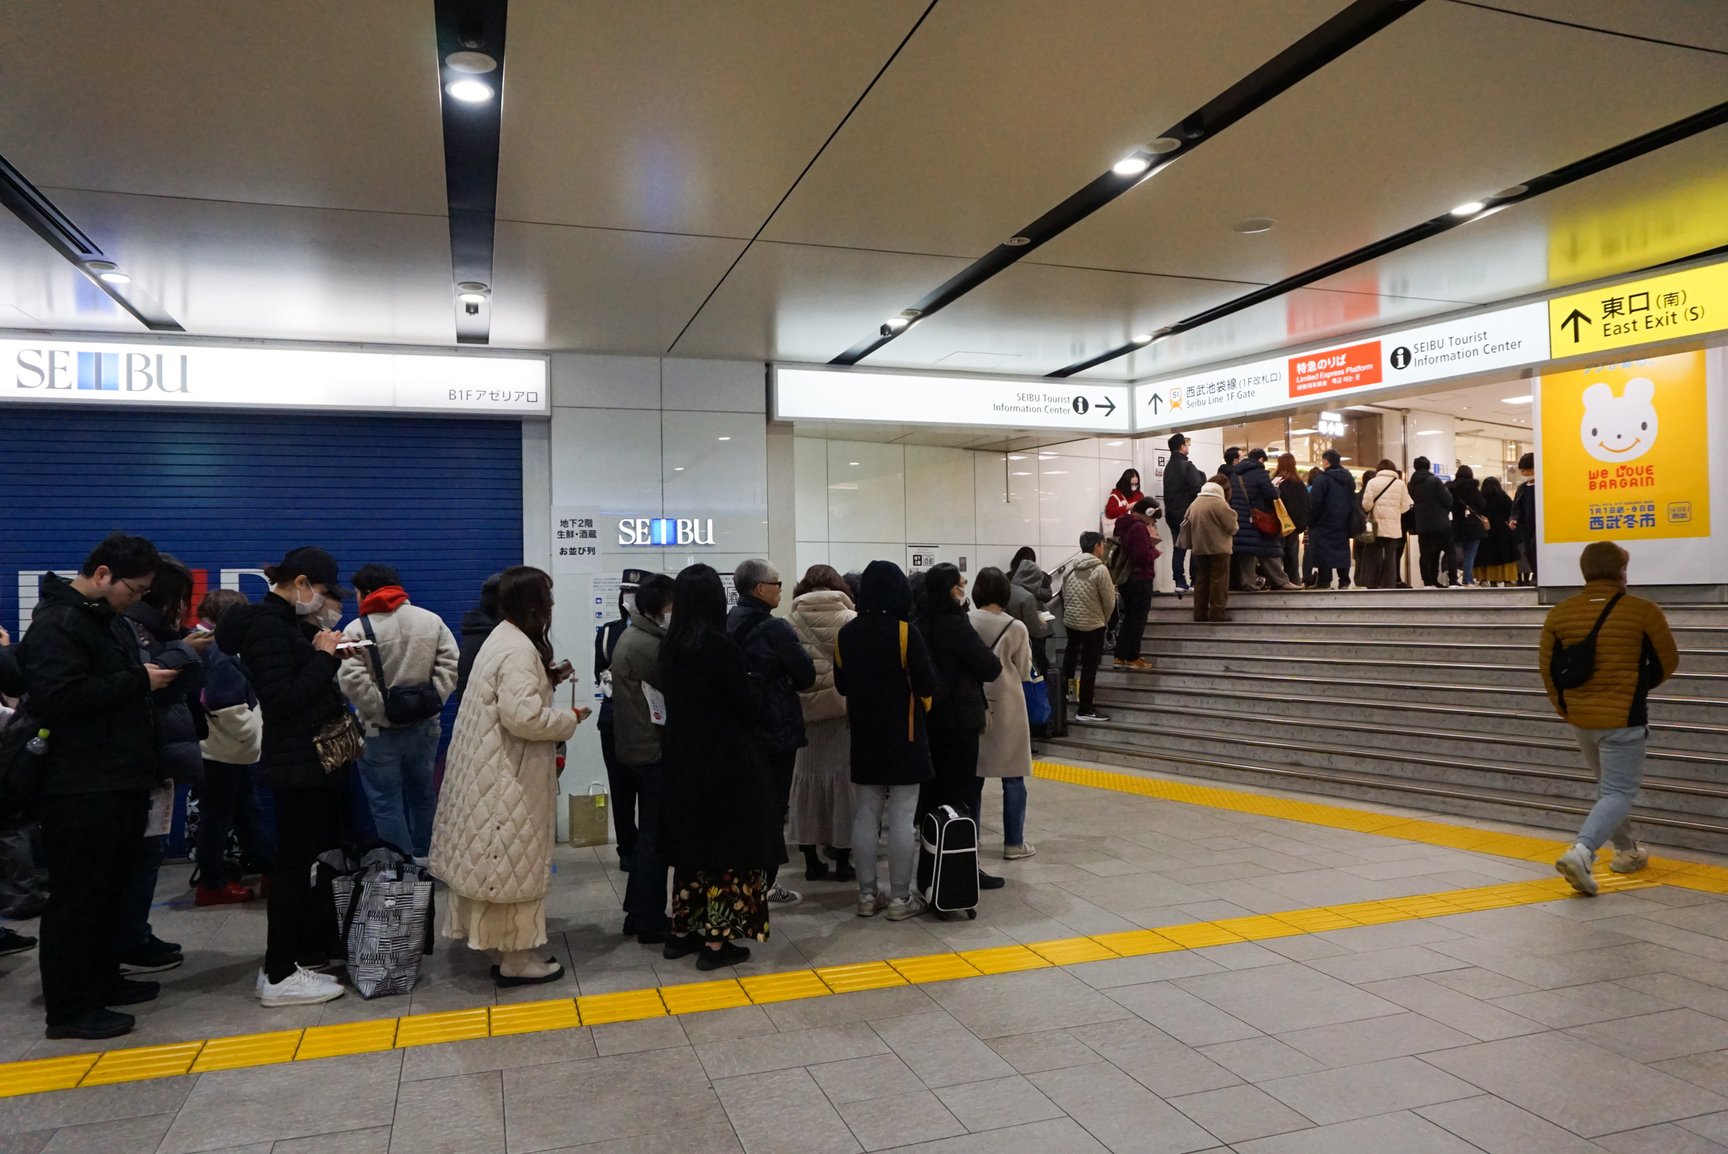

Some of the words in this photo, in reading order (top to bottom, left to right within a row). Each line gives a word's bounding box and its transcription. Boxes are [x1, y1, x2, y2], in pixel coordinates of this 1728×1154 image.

[1603, 319, 1638, 337] East
[1645, 311, 1678, 329] Exit
[1684, 305, 1705, 322] (S)
[1413, 338, 1445, 354] SEIBU
[1449, 331, 1488, 347] Tourist
[1414, 348, 1479, 367] Information
[1483, 340, 1522, 355] Center
[16, 349, 192, 393] SEIBU
[1296, 353, 1347, 374] 特急のりば
[1296, 373, 1319, 383] Limited
[1319, 369, 1345, 380] Express
[1345, 364, 1374, 374] Platform
[1016, 393, 1041, 403] SEIBU
[1043, 394, 1071, 404] Tourist
[1186, 397, 1207, 409] Seibu
[1208, 395, 1224, 405] Line
[1227, 392, 1235, 401] 1F
[1237, 389, 1256, 400] Gate
[993, 403, 1042, 413] Information
[1044, 405, 1071, 415] Center
[1589, 476, 1655, 491] BARGAIN
[560, 518, 594, 529] 地下2階
[1589, 513, 1656, 530] 西武冬市
[556, 529, 598, 540] 生鮮・酒蔵
[618, 518, 716, 545] SEIBU
[559, 546, 596, 556] お並び列
